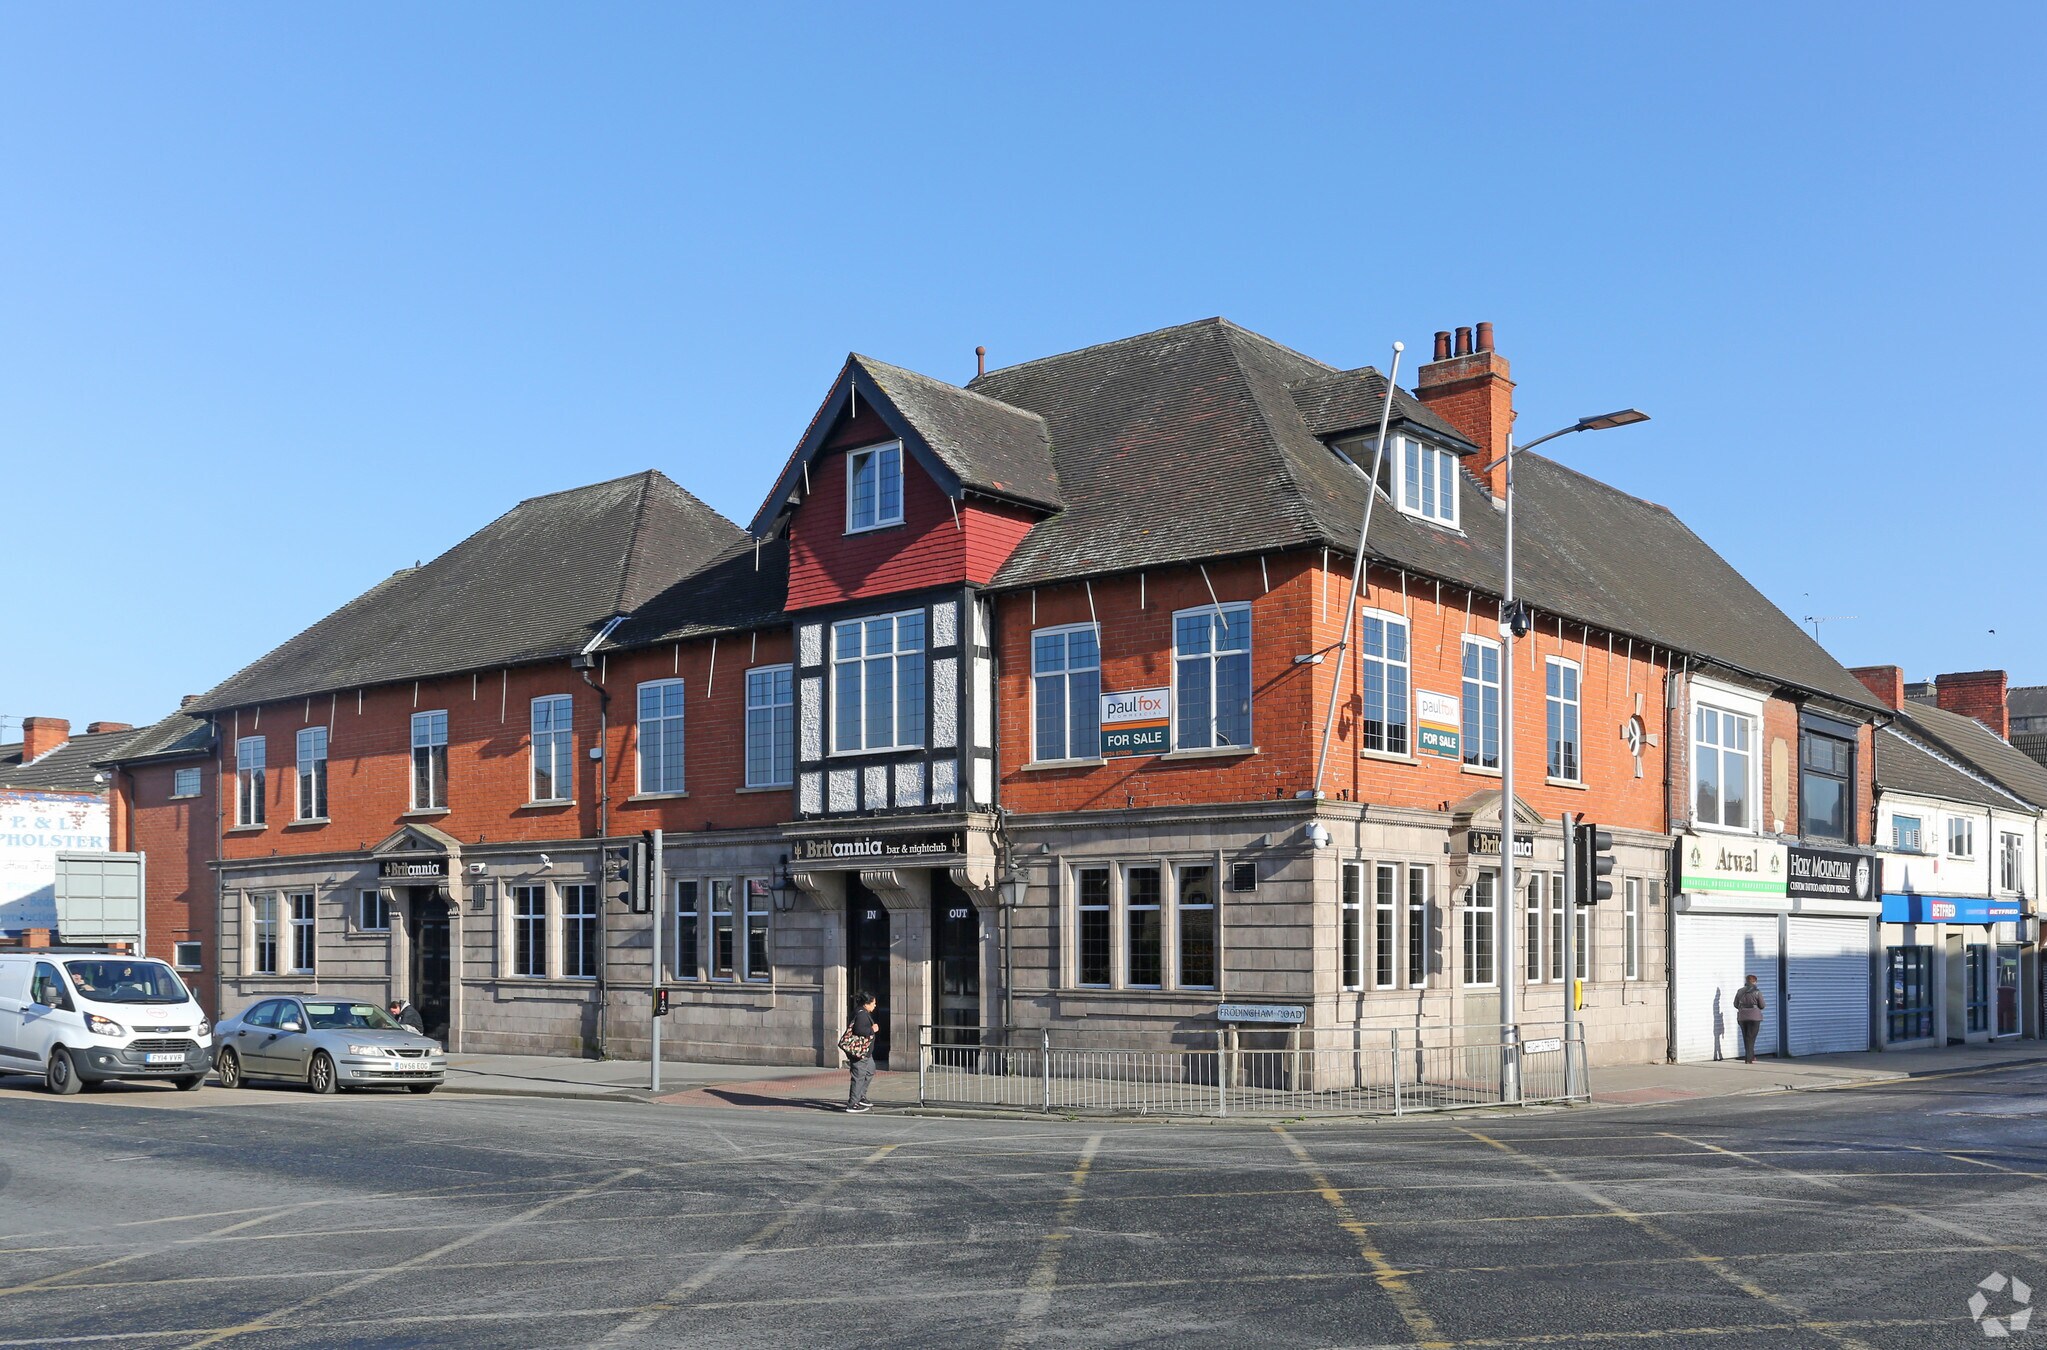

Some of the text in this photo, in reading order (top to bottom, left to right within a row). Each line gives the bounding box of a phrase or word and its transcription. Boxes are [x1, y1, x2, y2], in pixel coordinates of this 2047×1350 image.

[1112, 711, 1161, 719] COMMERCIAL
[1107, 731, 1162, 747] FOR SALE
[1423, 732, 1456, 749] FOR SALE
[34, 816, 52, 829] &
[0, 833, 110, 848] HOLSTER
[806, 836, 947, 858] Britannia bar & nightclub
[1481, 833, 1532, 856] Britnia
[1715, 846, 1758, 872] Atwal
[391, 860, 440, 876] Britannia
[1790, 854, 1851, 880] HOLY MOUNTAIN
[866, 910, 876, 919] IN
[949, 909, 968, 918] OUT
[1932, 903, 1956, 917] BETFRED
[1220, 1008, 1302, 1019] FRODINGHAM ROAD
[1526, 1039, 1559, 1052] HIGH STREET
